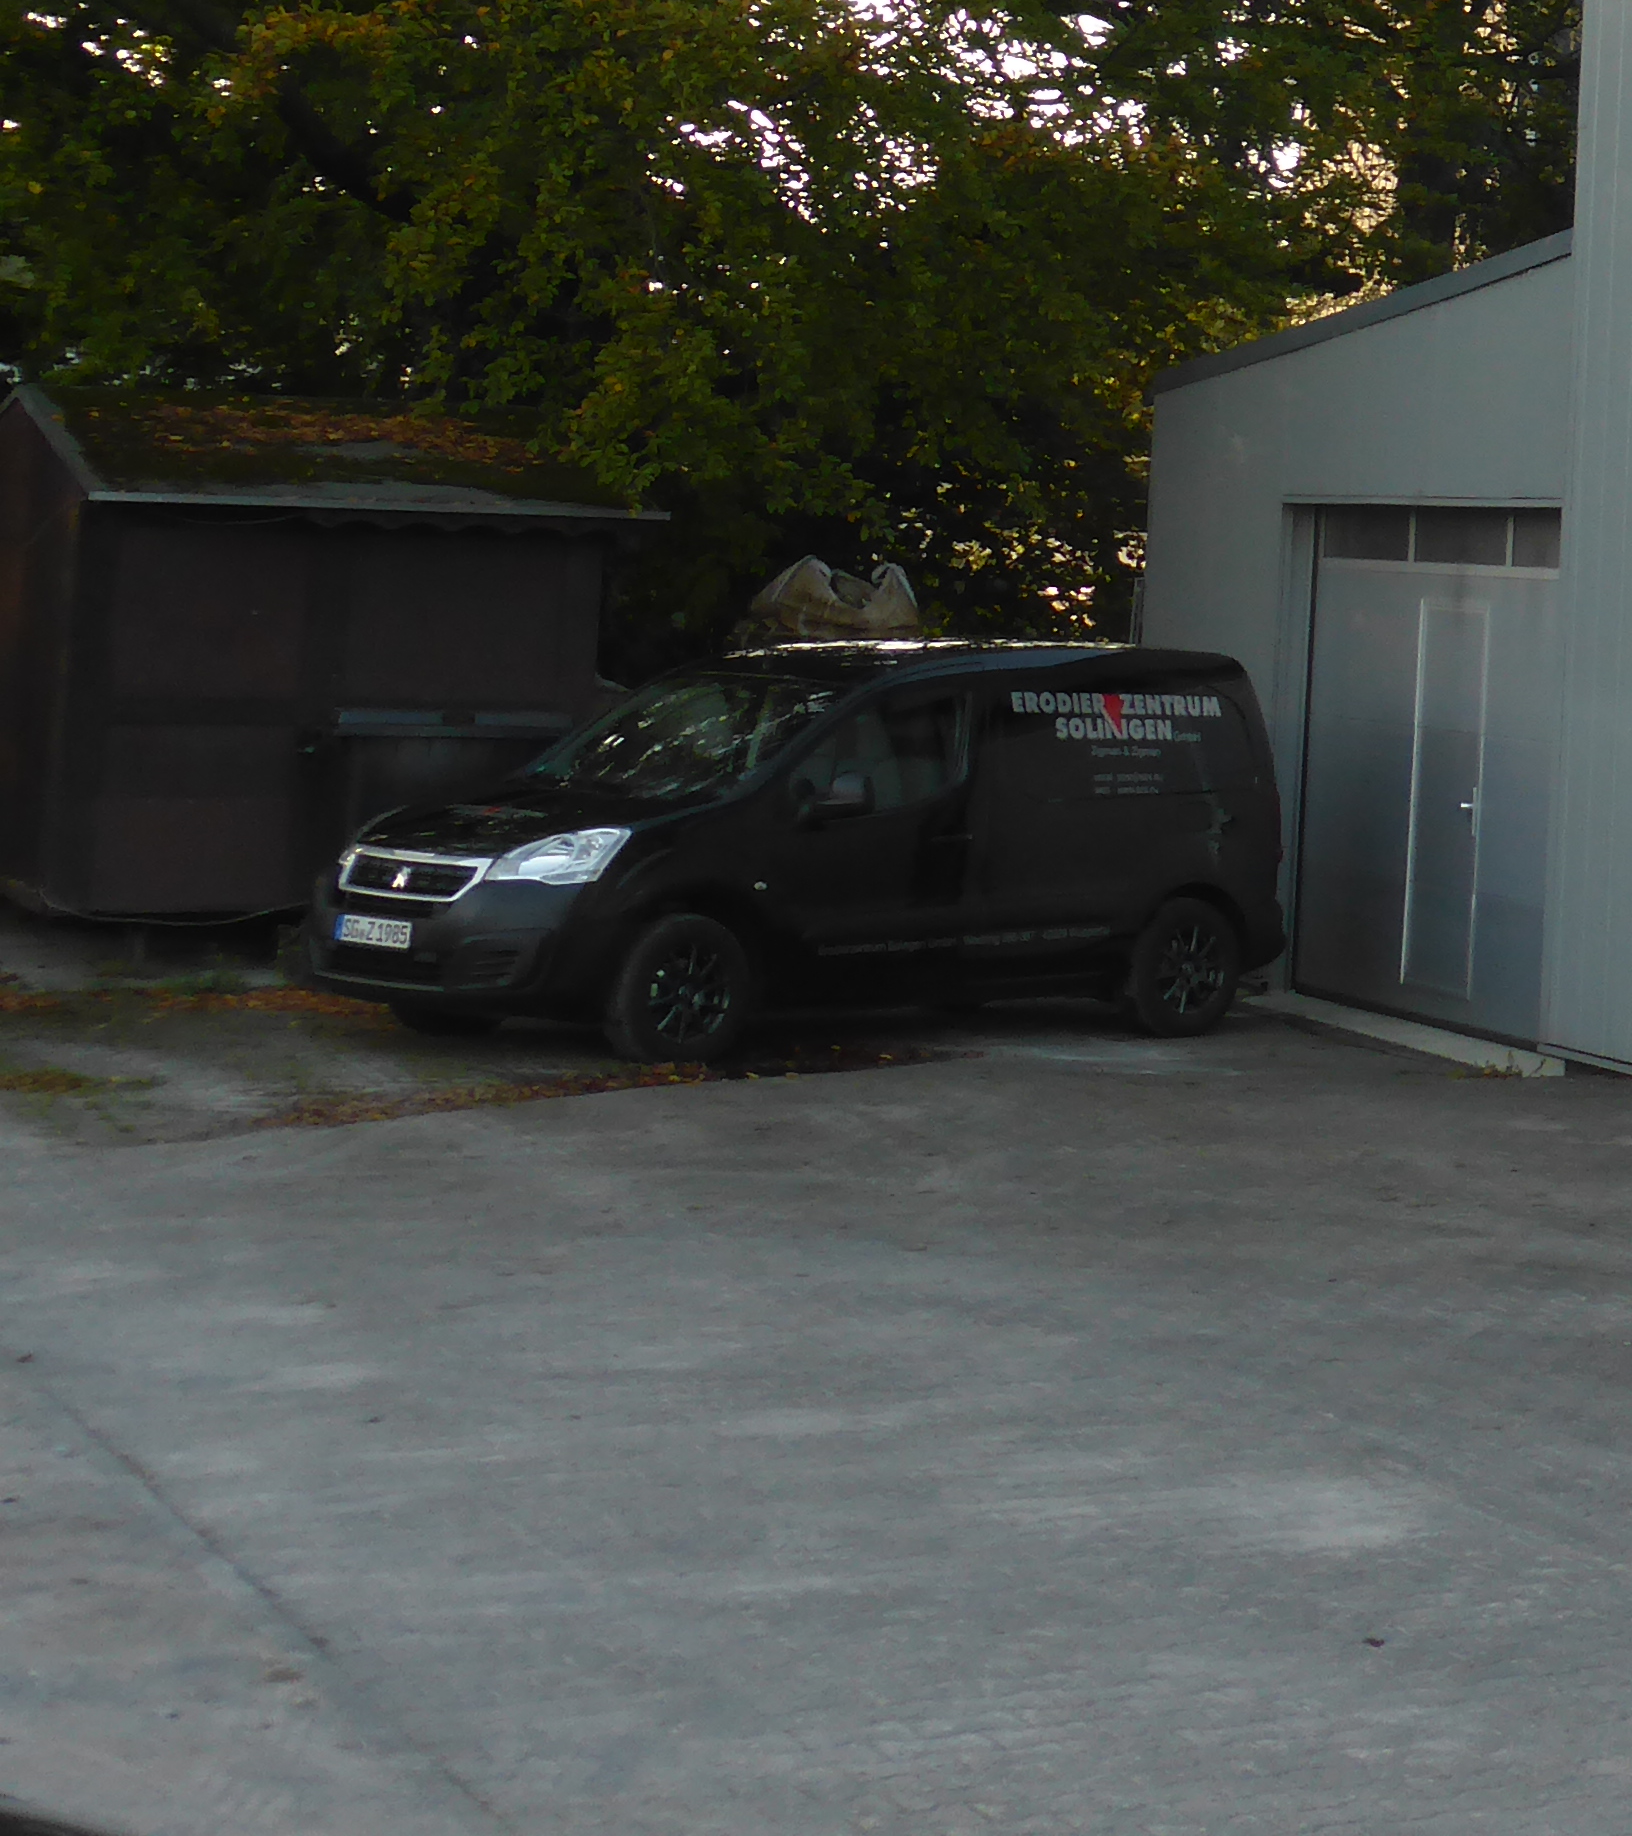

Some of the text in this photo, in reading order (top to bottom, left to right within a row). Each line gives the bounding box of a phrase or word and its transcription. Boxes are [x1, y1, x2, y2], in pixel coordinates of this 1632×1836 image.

[1011, 691, 1222, 717] ERODIER ZENTRUM
[1056, 717, 1172, 741] SOLINGEN
